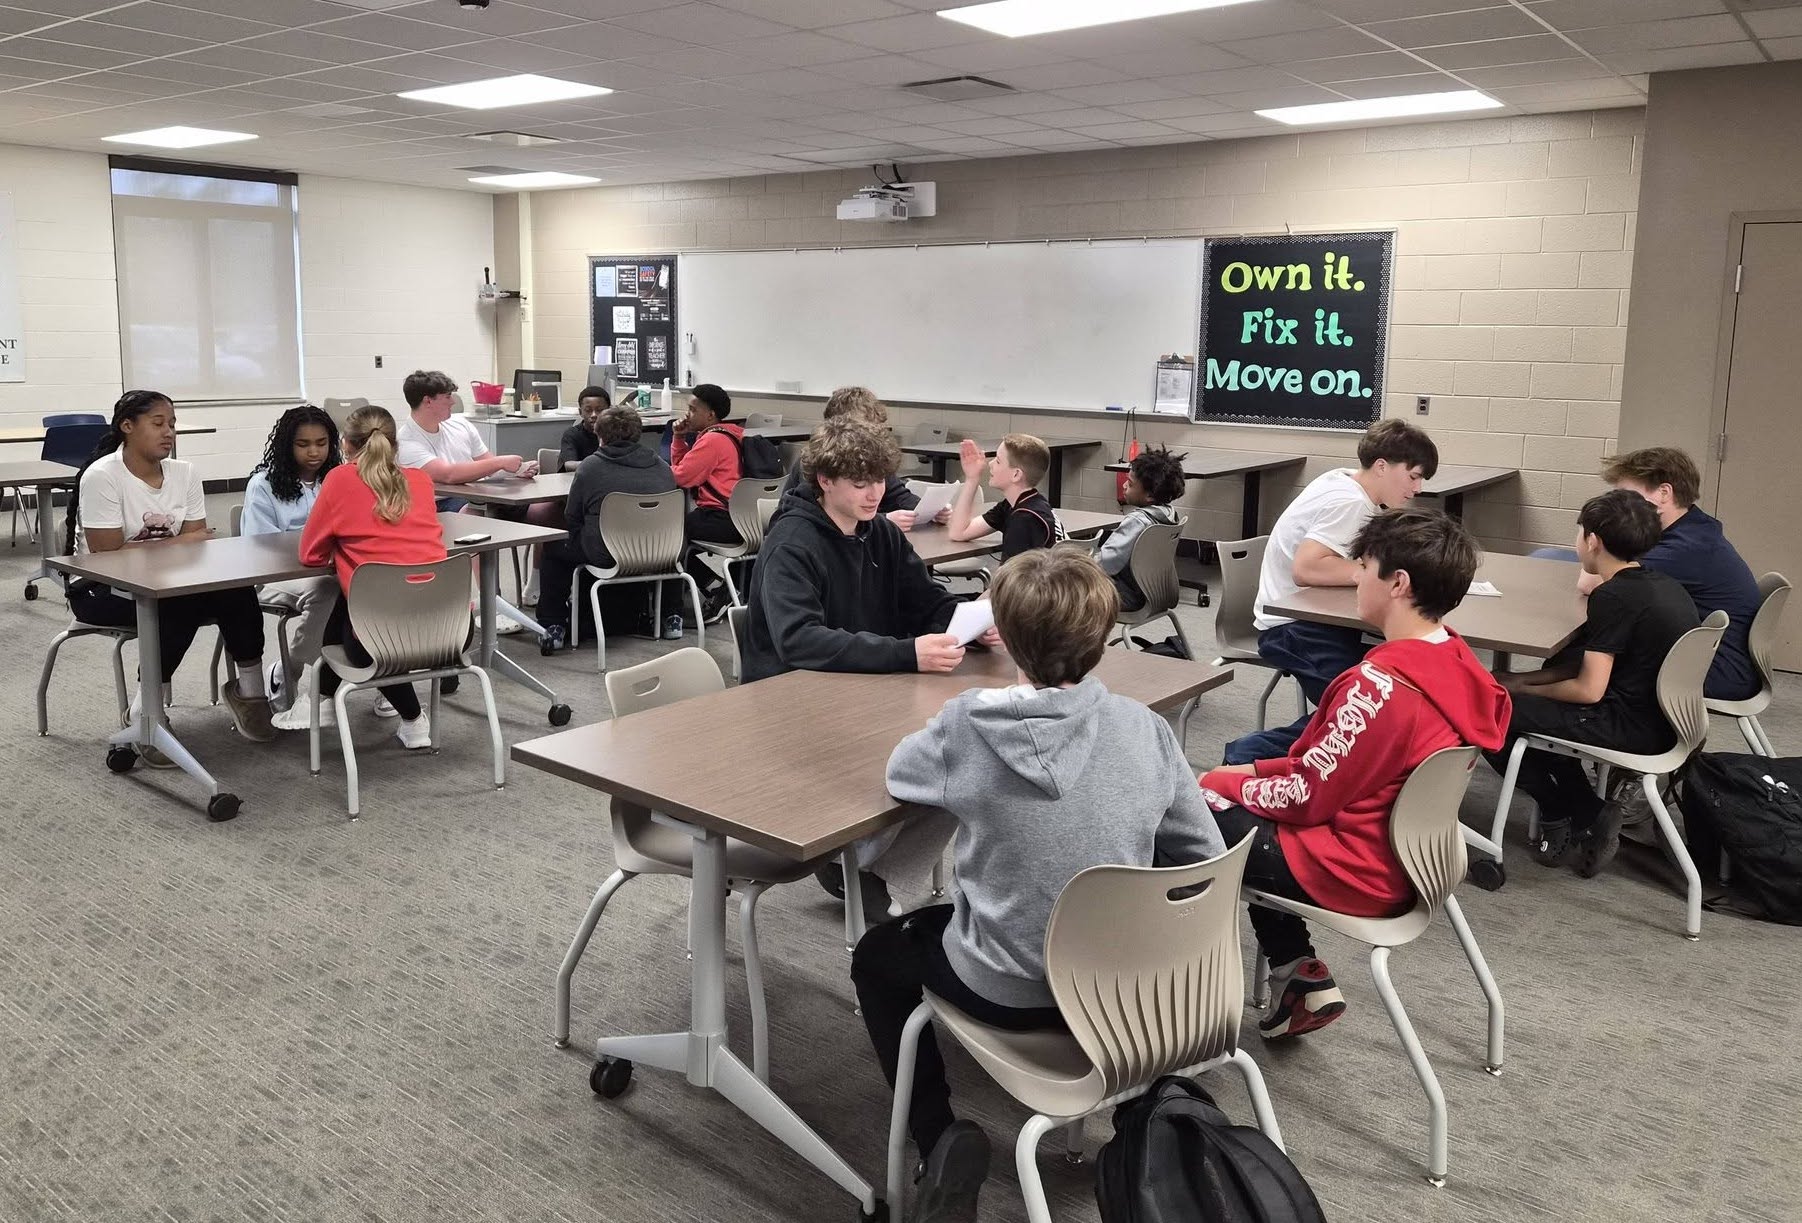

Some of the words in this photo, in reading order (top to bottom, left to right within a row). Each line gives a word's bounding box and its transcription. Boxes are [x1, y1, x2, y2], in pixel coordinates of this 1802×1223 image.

[1221, 262, 1312, 293] Own
[1324, 252, 1365, 291] it.
[1241, 308, 1298, 344] Fix
[1315, 308, 1353, 346] it.
[1205, 358, 1303, 394] Move
[1310, 369, 1373, 398] on.
